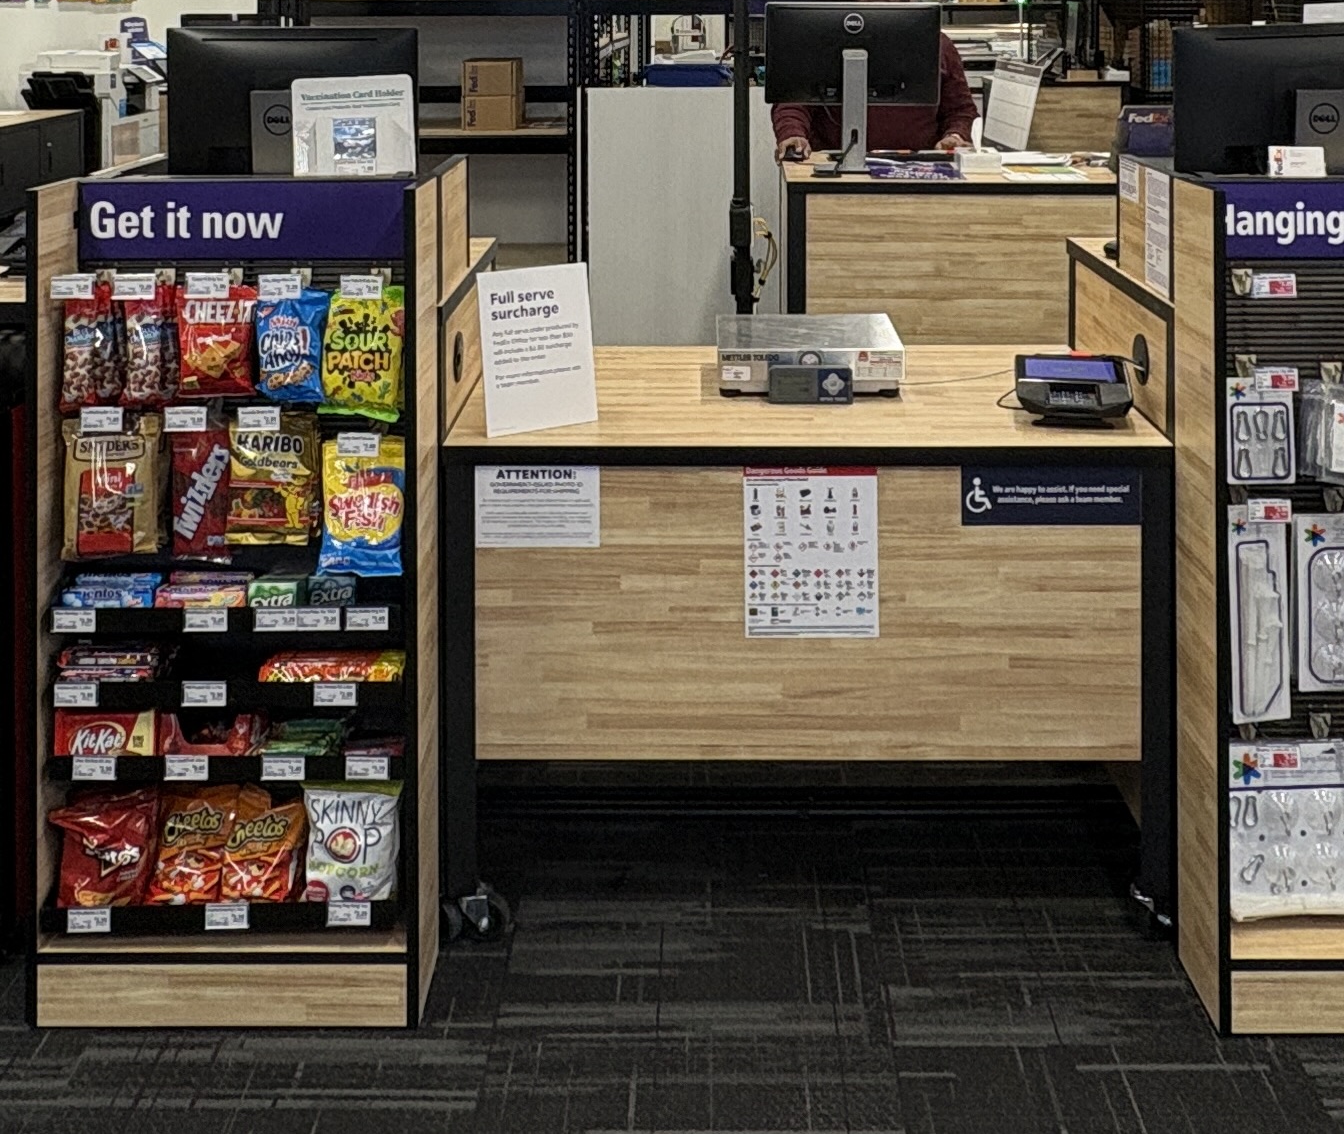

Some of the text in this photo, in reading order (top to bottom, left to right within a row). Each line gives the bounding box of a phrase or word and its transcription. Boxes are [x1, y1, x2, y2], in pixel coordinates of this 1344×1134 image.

[352, 89, 373, 99] Card
[375, 88, 405, 98] Holder
[1128, 113, 1171, 124] FedEx
[1313, 114, 1337, 123] DELL
[90, 200, 284, 240] Get it now
[490, 290, 554, 305] Full serve
[491, 305, 559, 321] surcharge
[331, 332, 388, 351] SOUR
[326, 352, 391, 370] PATCH
[722, 353, 752, 362] METTLER
[237, 433, 303, 454] HARIBO
[992, 485, 1003, 493] We
[1016, 485, 1037, 495] happy
[1106, 484, 1130, 494] special
[250, 592, 294, 607] Extra
[310, 586, 353, 605] Extra
[310, 794, 386, 825] SKINNY
